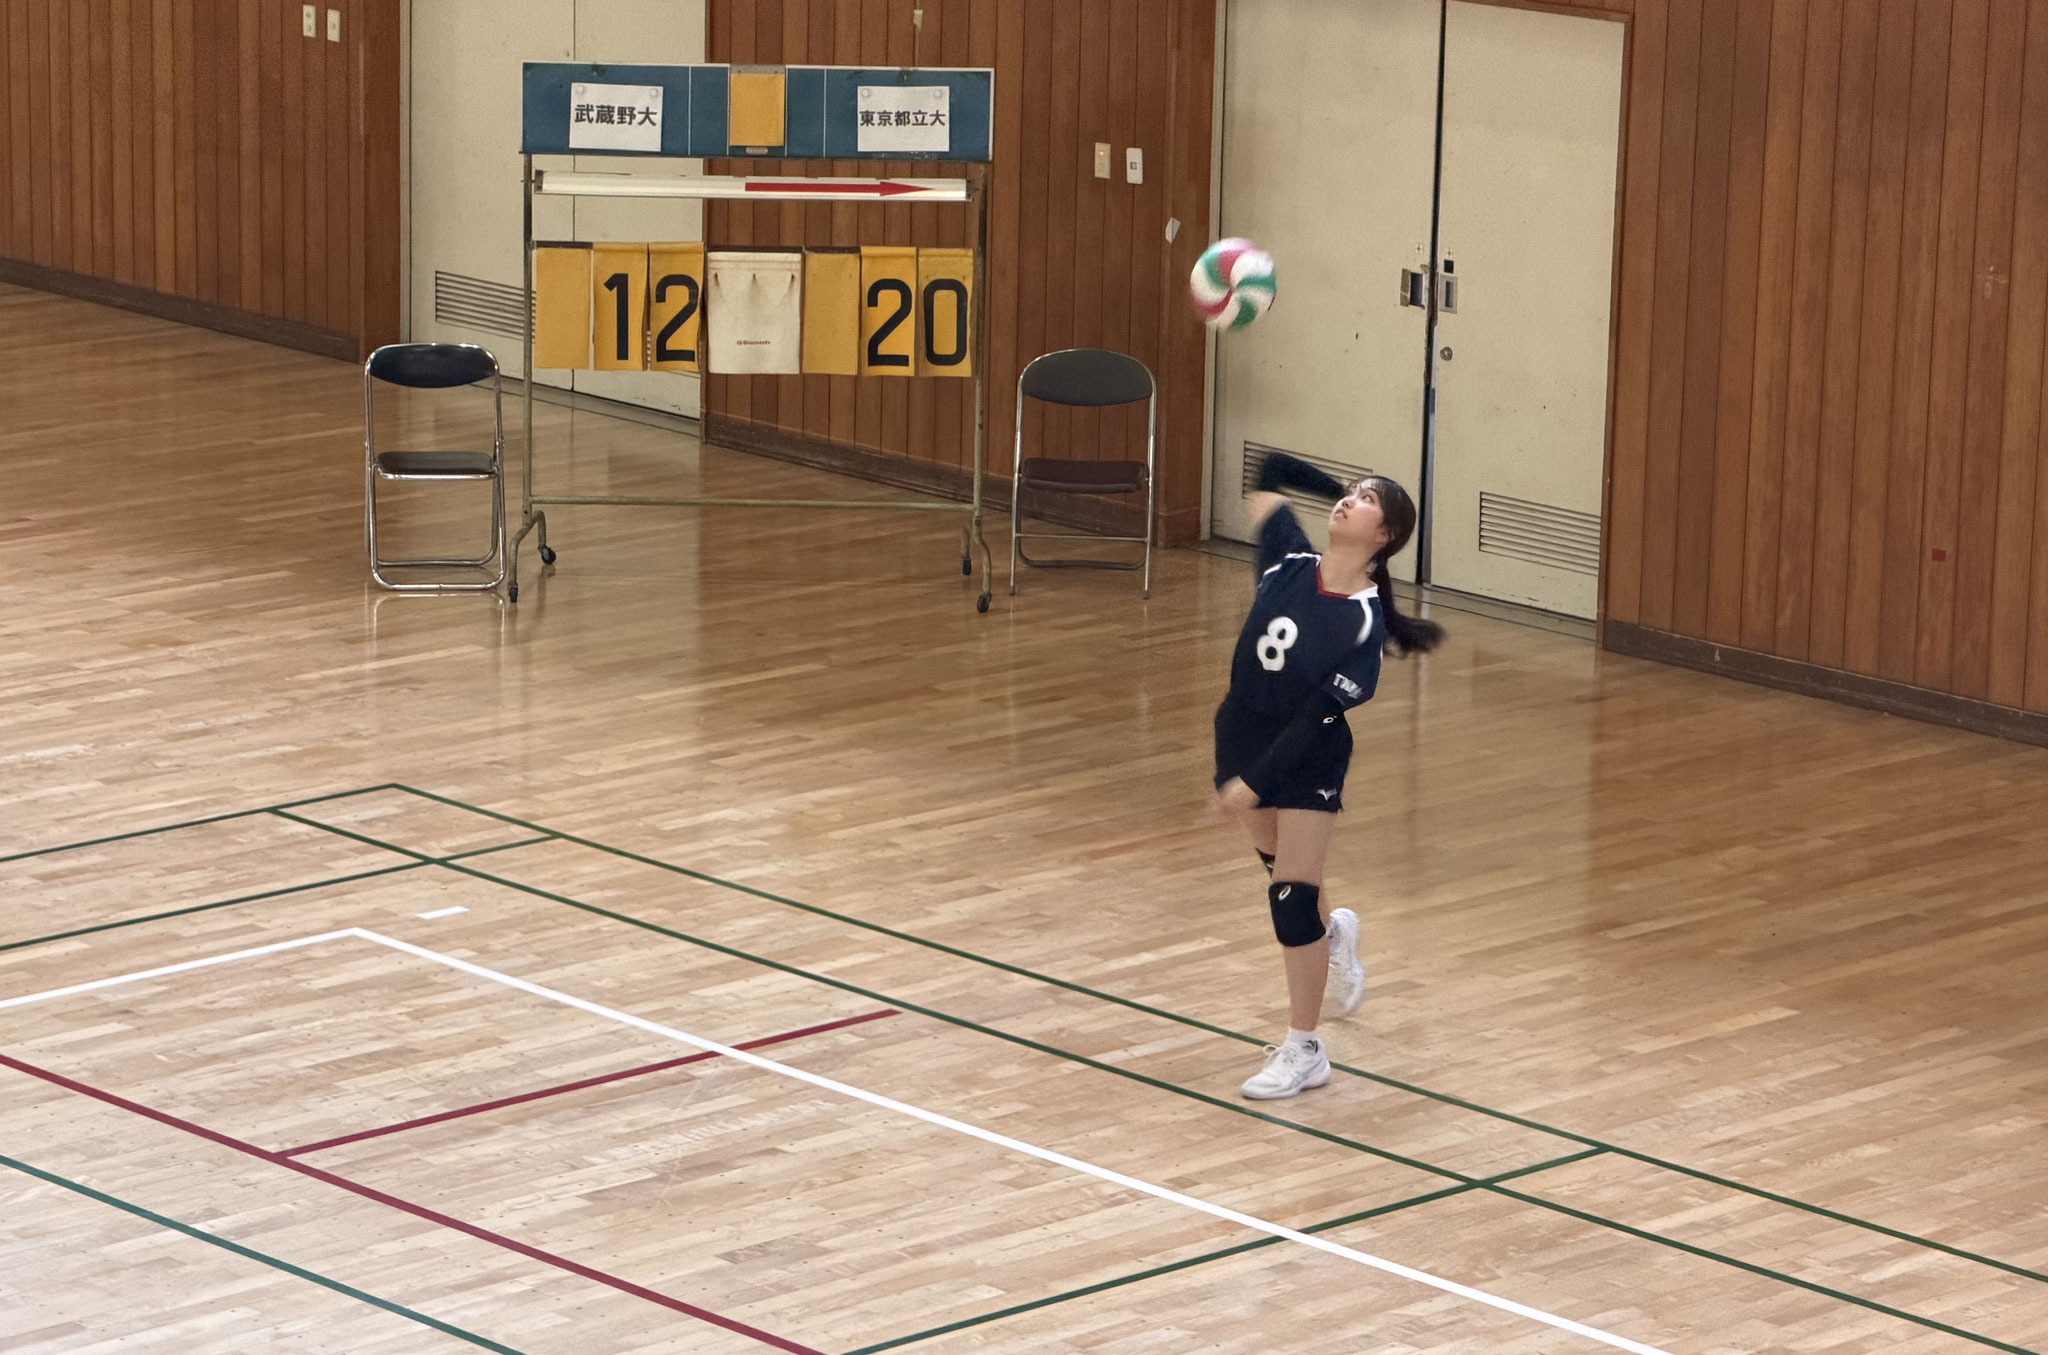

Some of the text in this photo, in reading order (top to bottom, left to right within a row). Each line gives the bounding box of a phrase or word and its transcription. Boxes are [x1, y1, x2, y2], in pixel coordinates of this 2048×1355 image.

[574, 103, 658, 127] 武蔵野大
[859, 109, 946, 127] 東京都立大
[603, 272, 699, 363] 12
[867, 278, 968, 367] 20
[1257, 616, 1298, 671] 8
